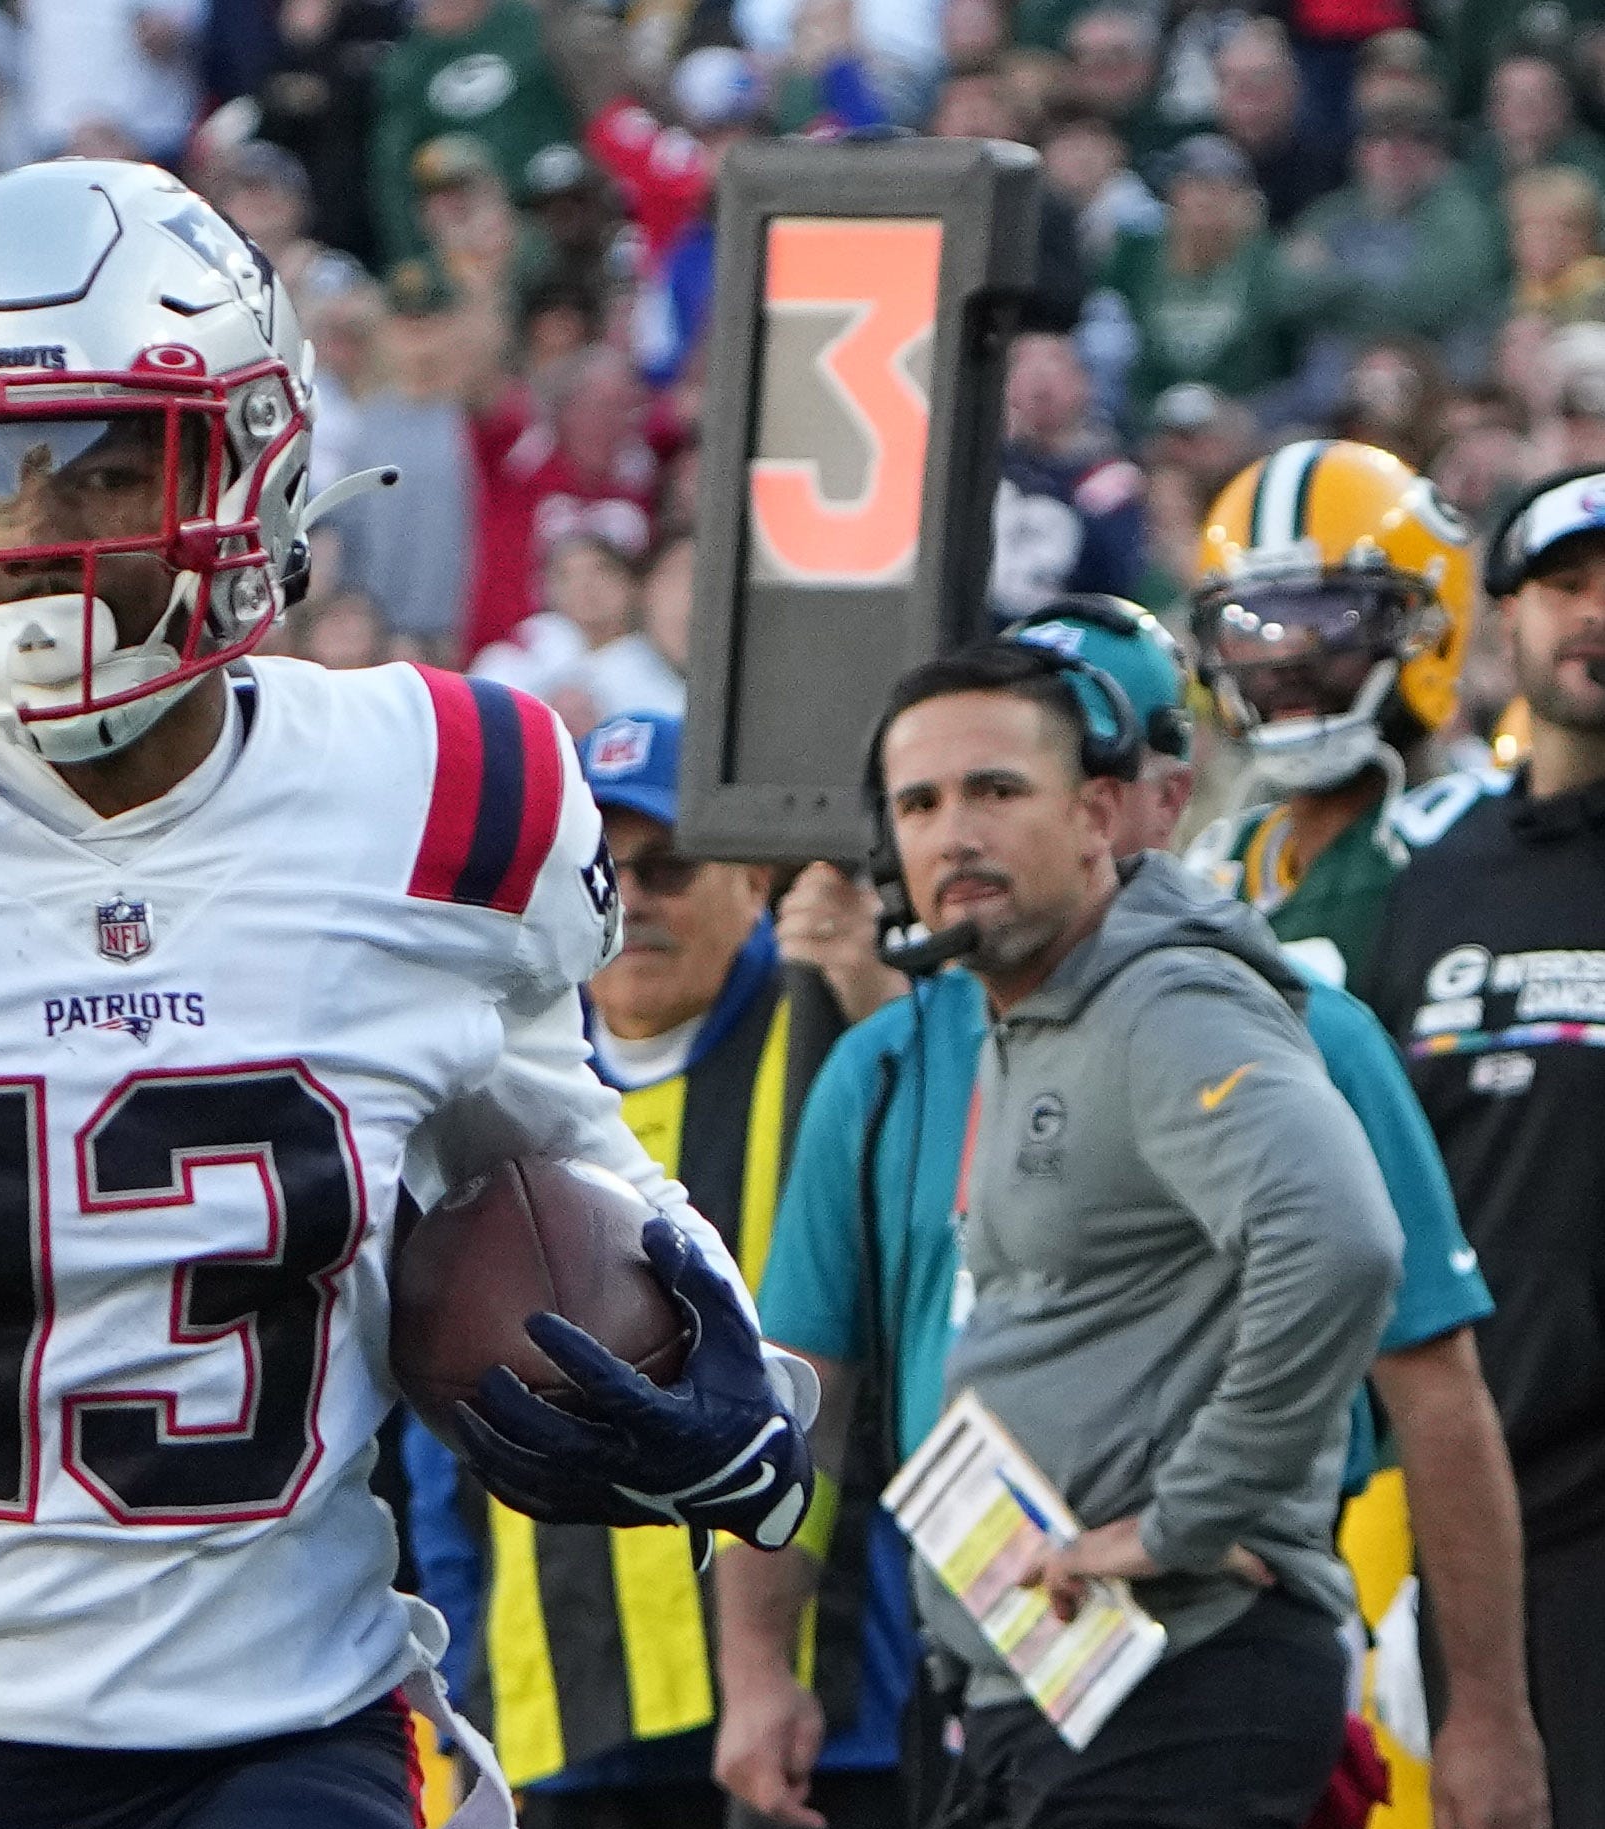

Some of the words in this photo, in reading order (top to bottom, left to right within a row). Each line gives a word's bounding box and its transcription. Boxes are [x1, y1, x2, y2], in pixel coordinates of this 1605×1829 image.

[751, 218, 943, 577] 3
[104, 924, 147, 954] NFL
[43, 992, 205, 1037] PATRIOTS
